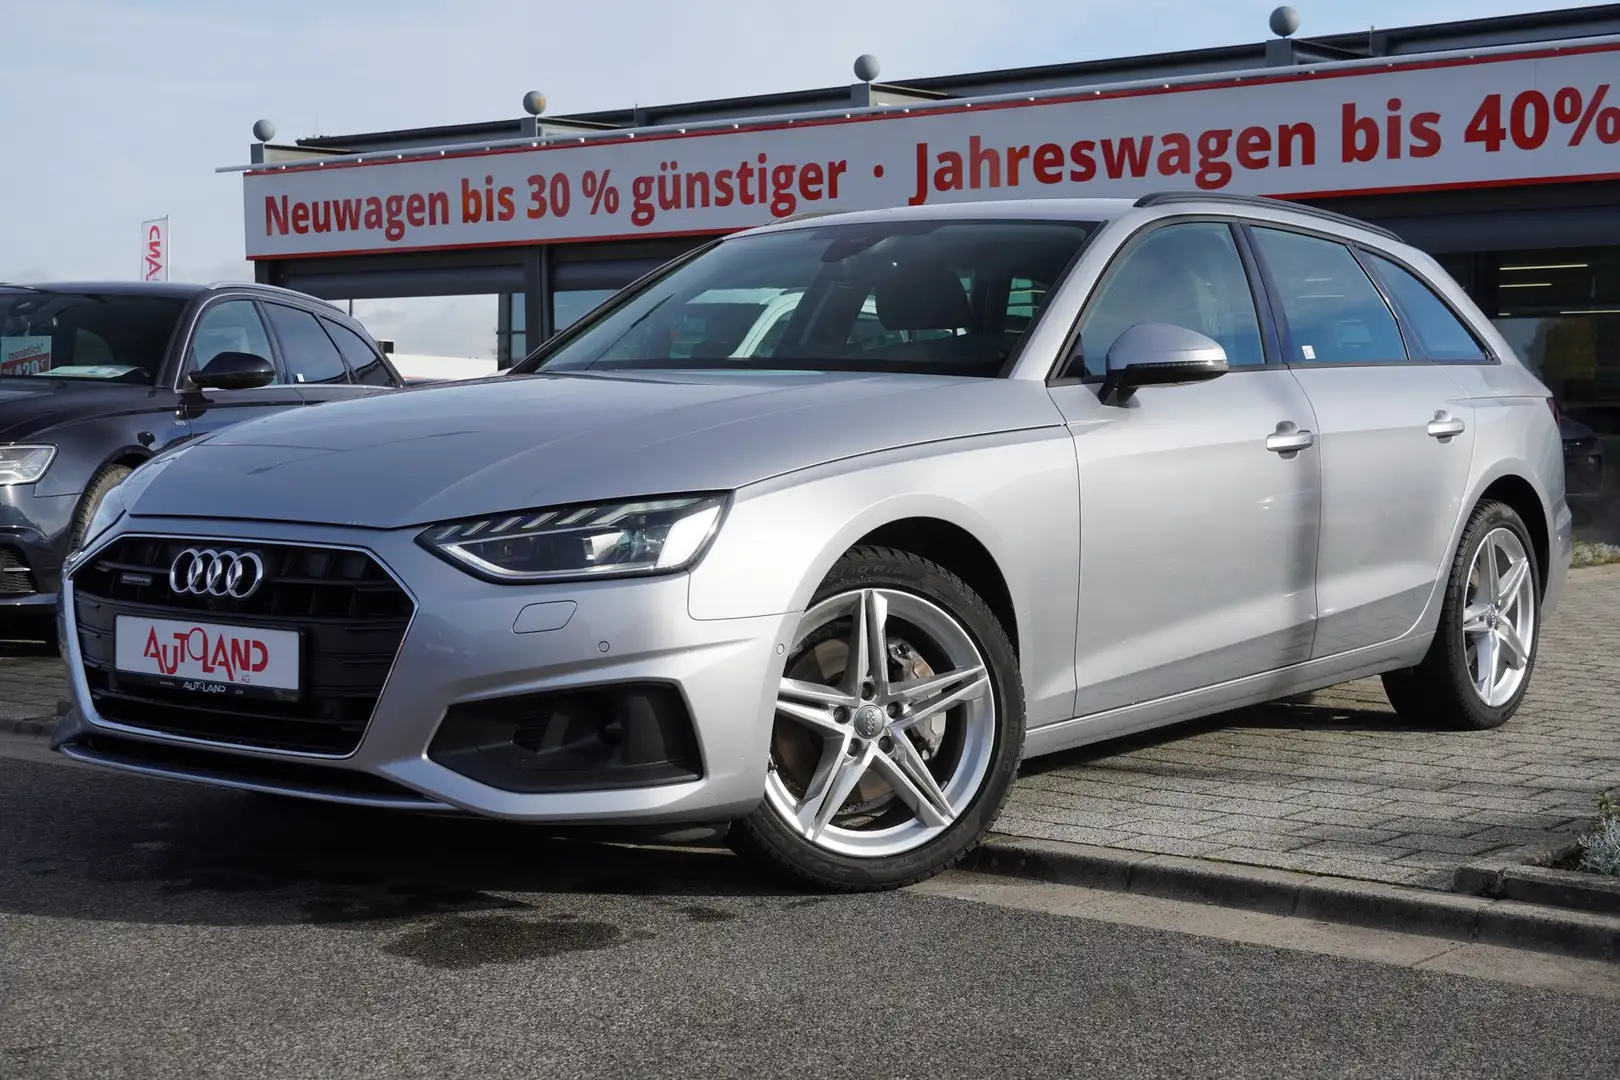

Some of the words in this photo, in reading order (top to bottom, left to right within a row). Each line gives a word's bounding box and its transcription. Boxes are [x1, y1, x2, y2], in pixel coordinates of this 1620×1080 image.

[264, 191, 449, 241] Neuwagen
[461, 175, 515, 224] bis
[527, 172, 570, 219] 30
[582, 169, 619, 215] %
[631, 153, 847, 227] günstiger
[908, 121, 1316, 207] Jahreswagen
[1342, 98, 1442, 163] bis
[1464, 84, 1620, 152] 40%
